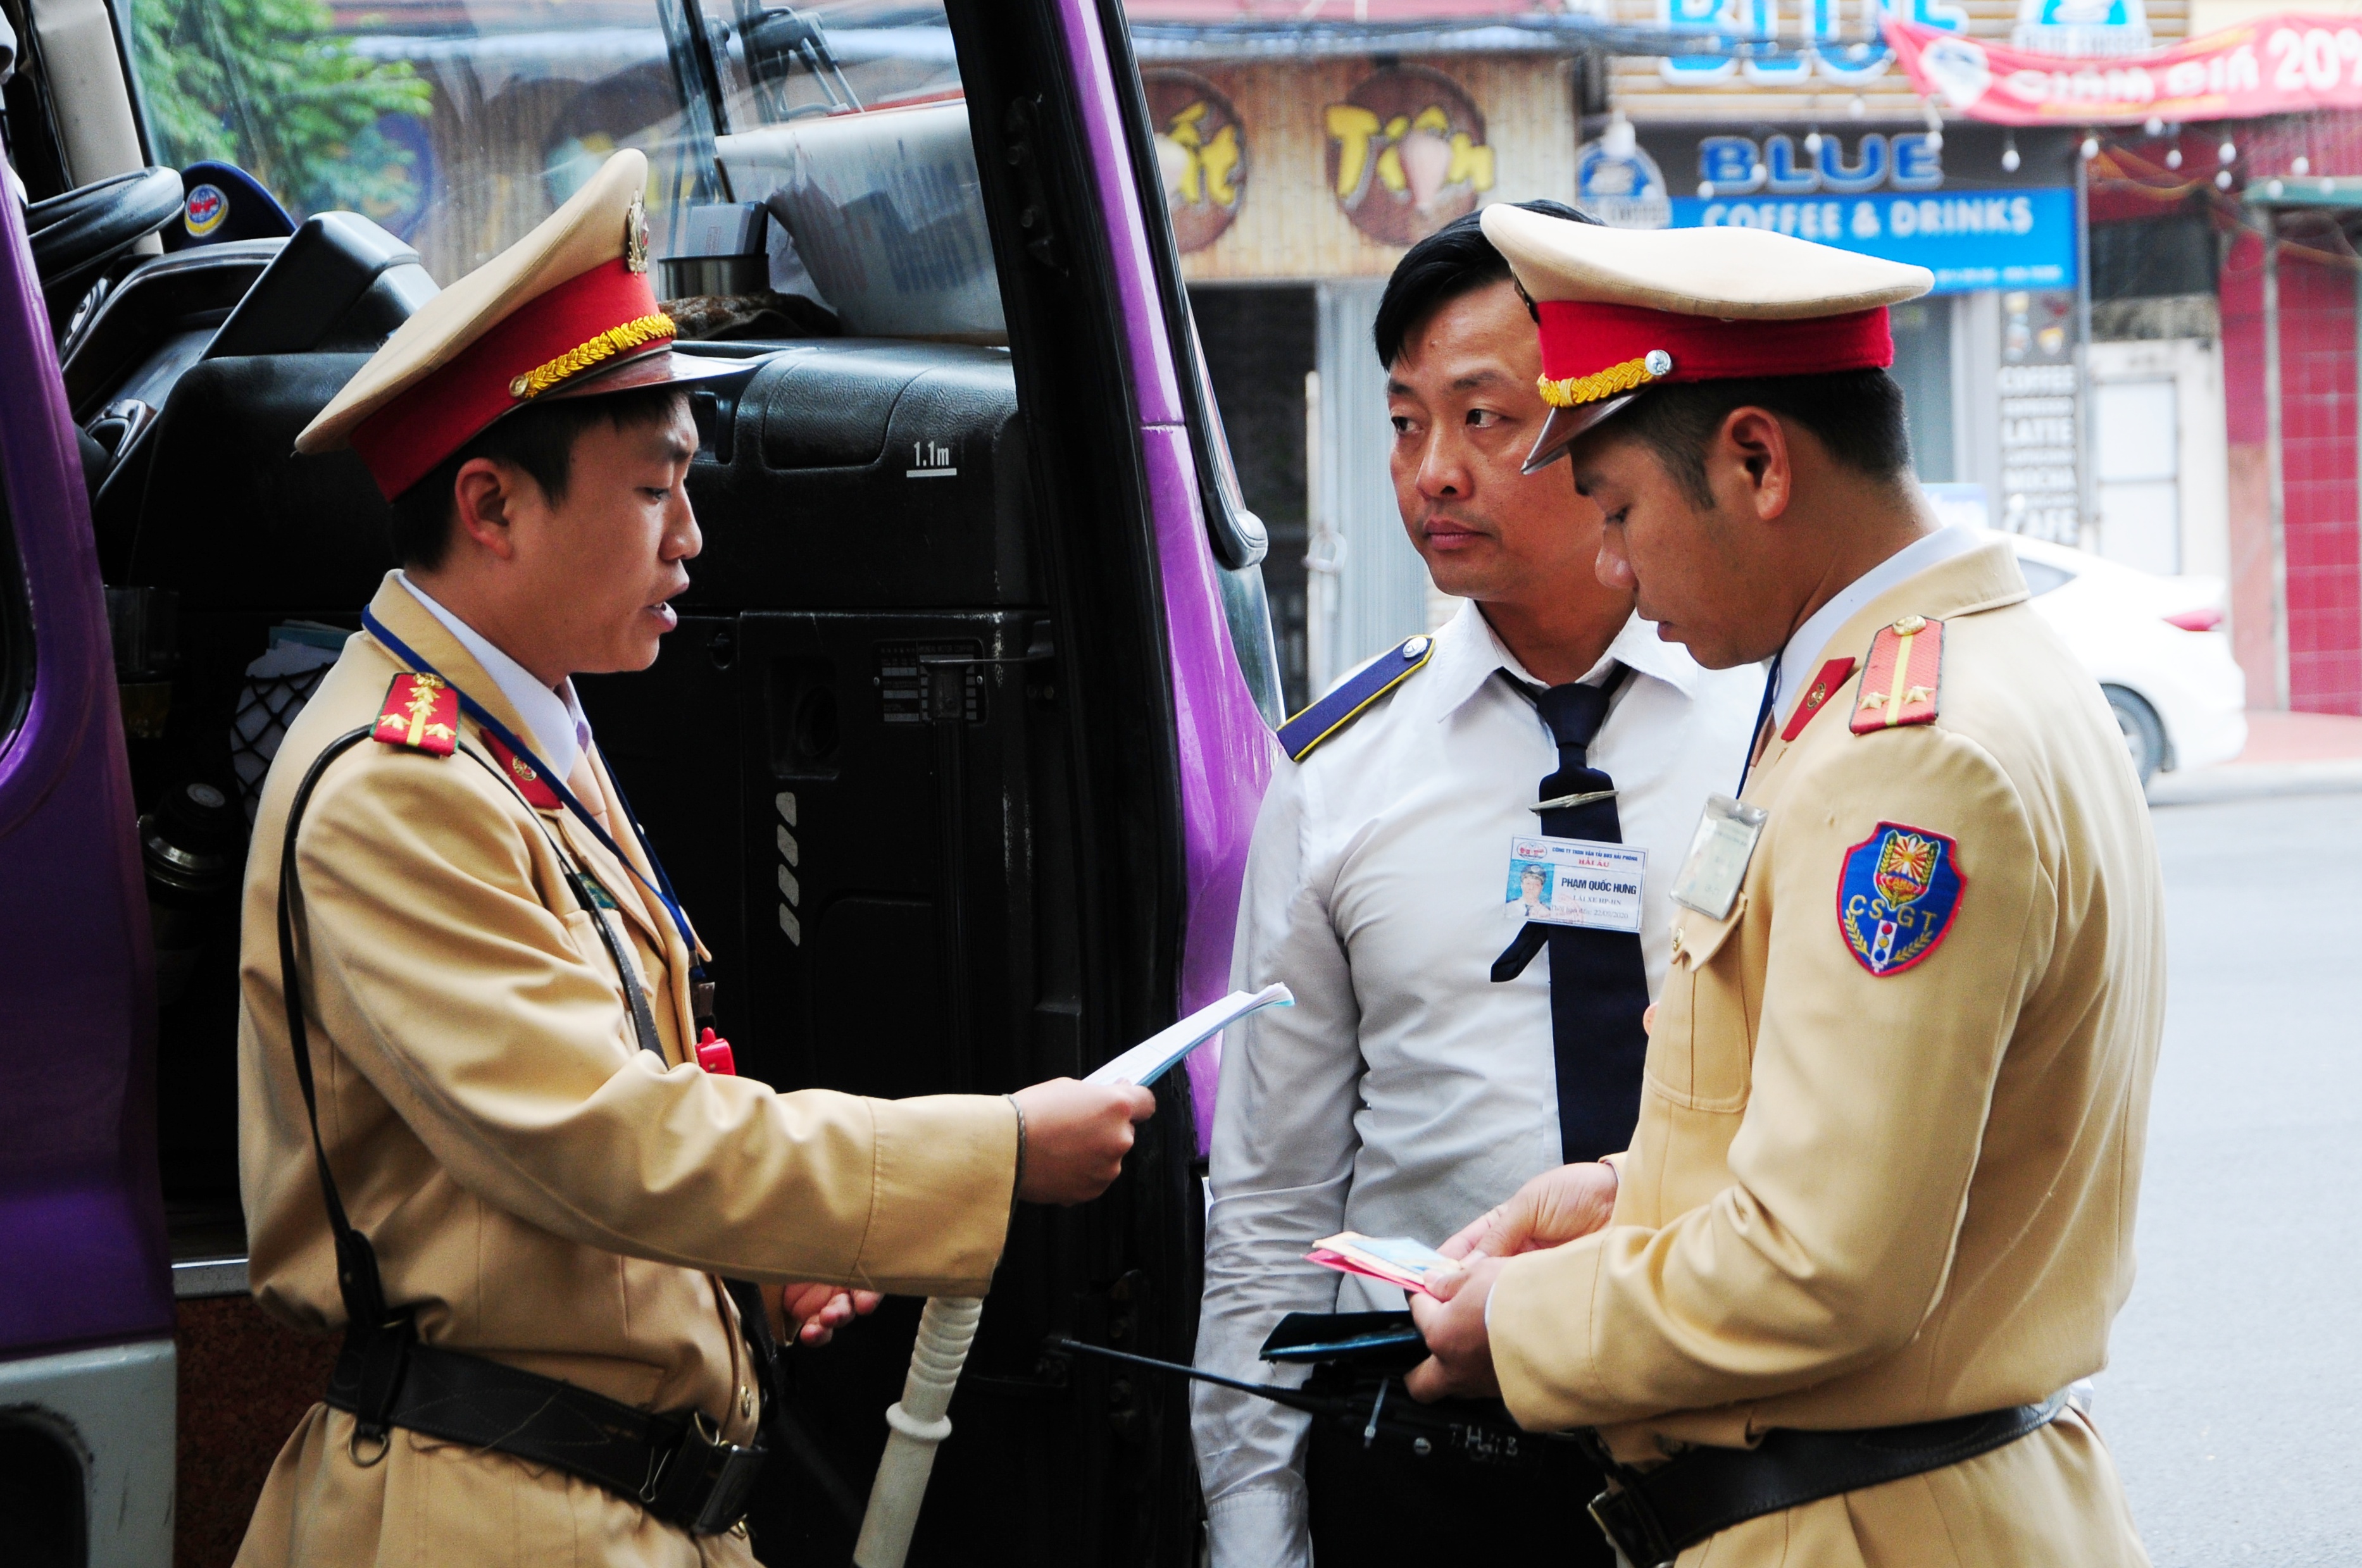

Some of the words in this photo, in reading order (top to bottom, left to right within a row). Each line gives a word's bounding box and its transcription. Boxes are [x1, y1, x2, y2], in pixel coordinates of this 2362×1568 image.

[1699, 133, 1944, 194] BLUE
[1702, 202, 1842, 240] COFFEE
[1851, 201, 1880, 240] &
[1890, 196, 2034, 238] DRINKS
[914, 441, 949, 466] 1.1m
[1578, 857, 1594, 866] HẢI
[1561, 878, 1587, 890] PHẠM
[1589, 878, 1611, 892] QUỐC
